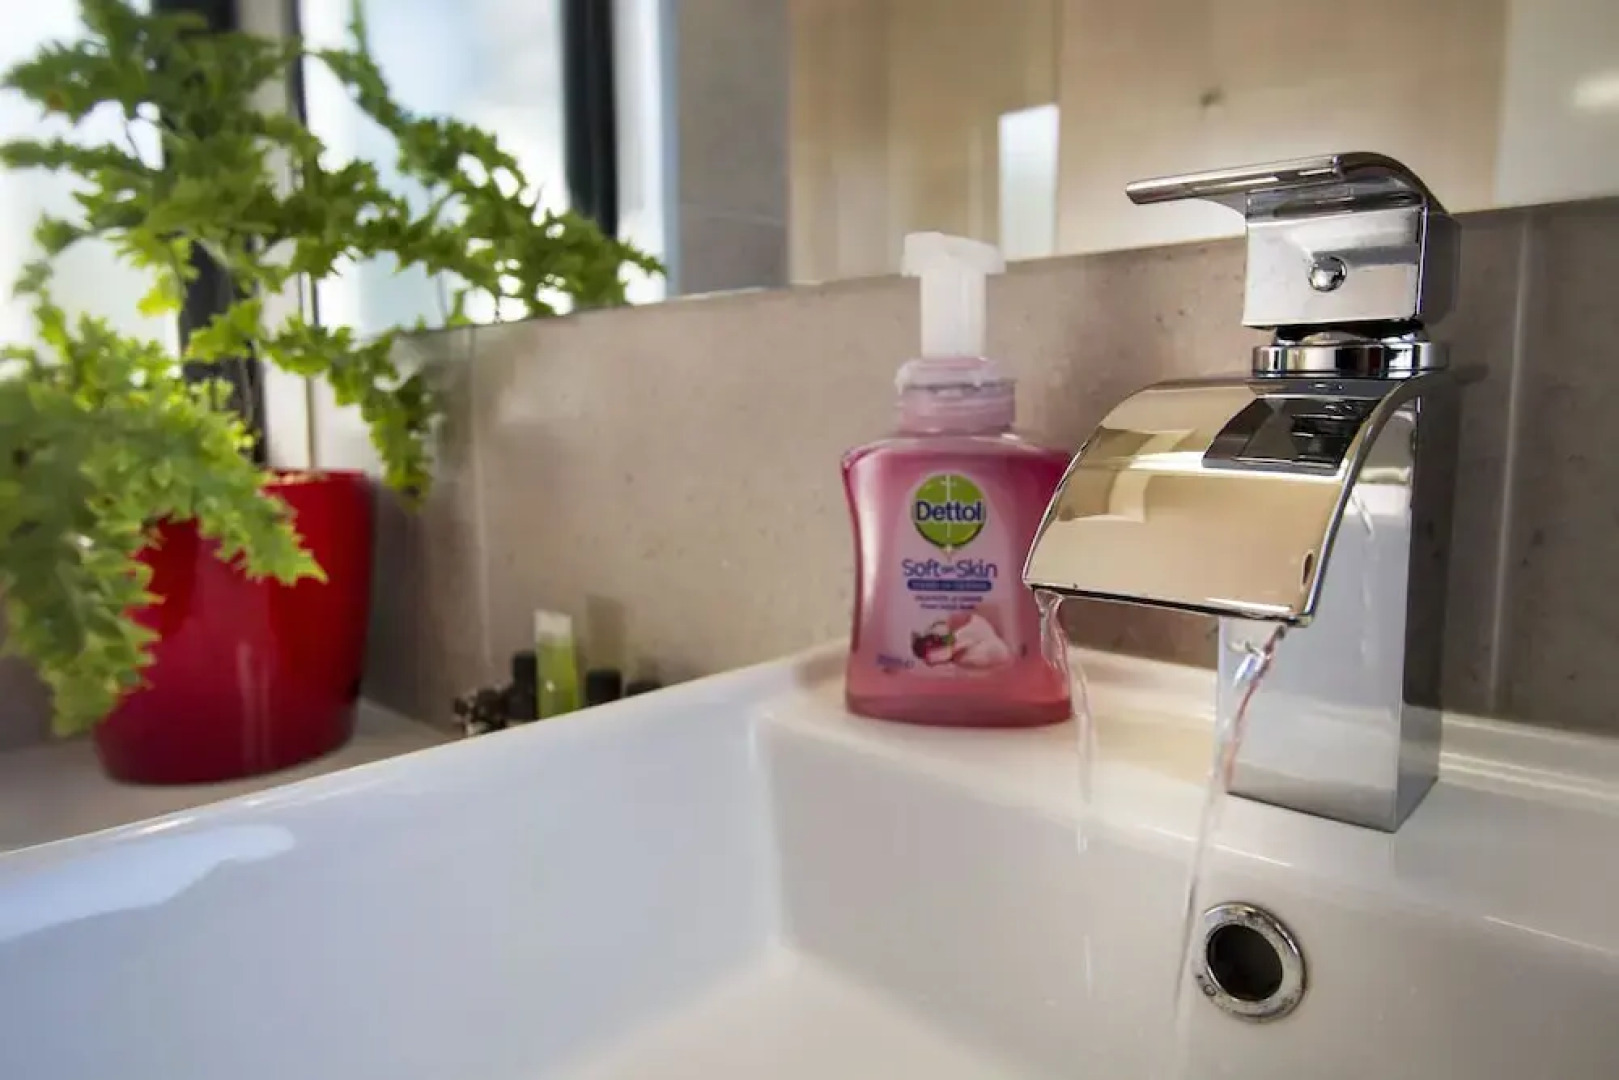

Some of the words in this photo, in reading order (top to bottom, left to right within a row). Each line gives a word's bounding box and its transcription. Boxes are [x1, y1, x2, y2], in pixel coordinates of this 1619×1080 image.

[917, 501, 982, 521] Dettol
[902, 558, 940, 577] Soft
[956, 558, 998, 578] Skin
